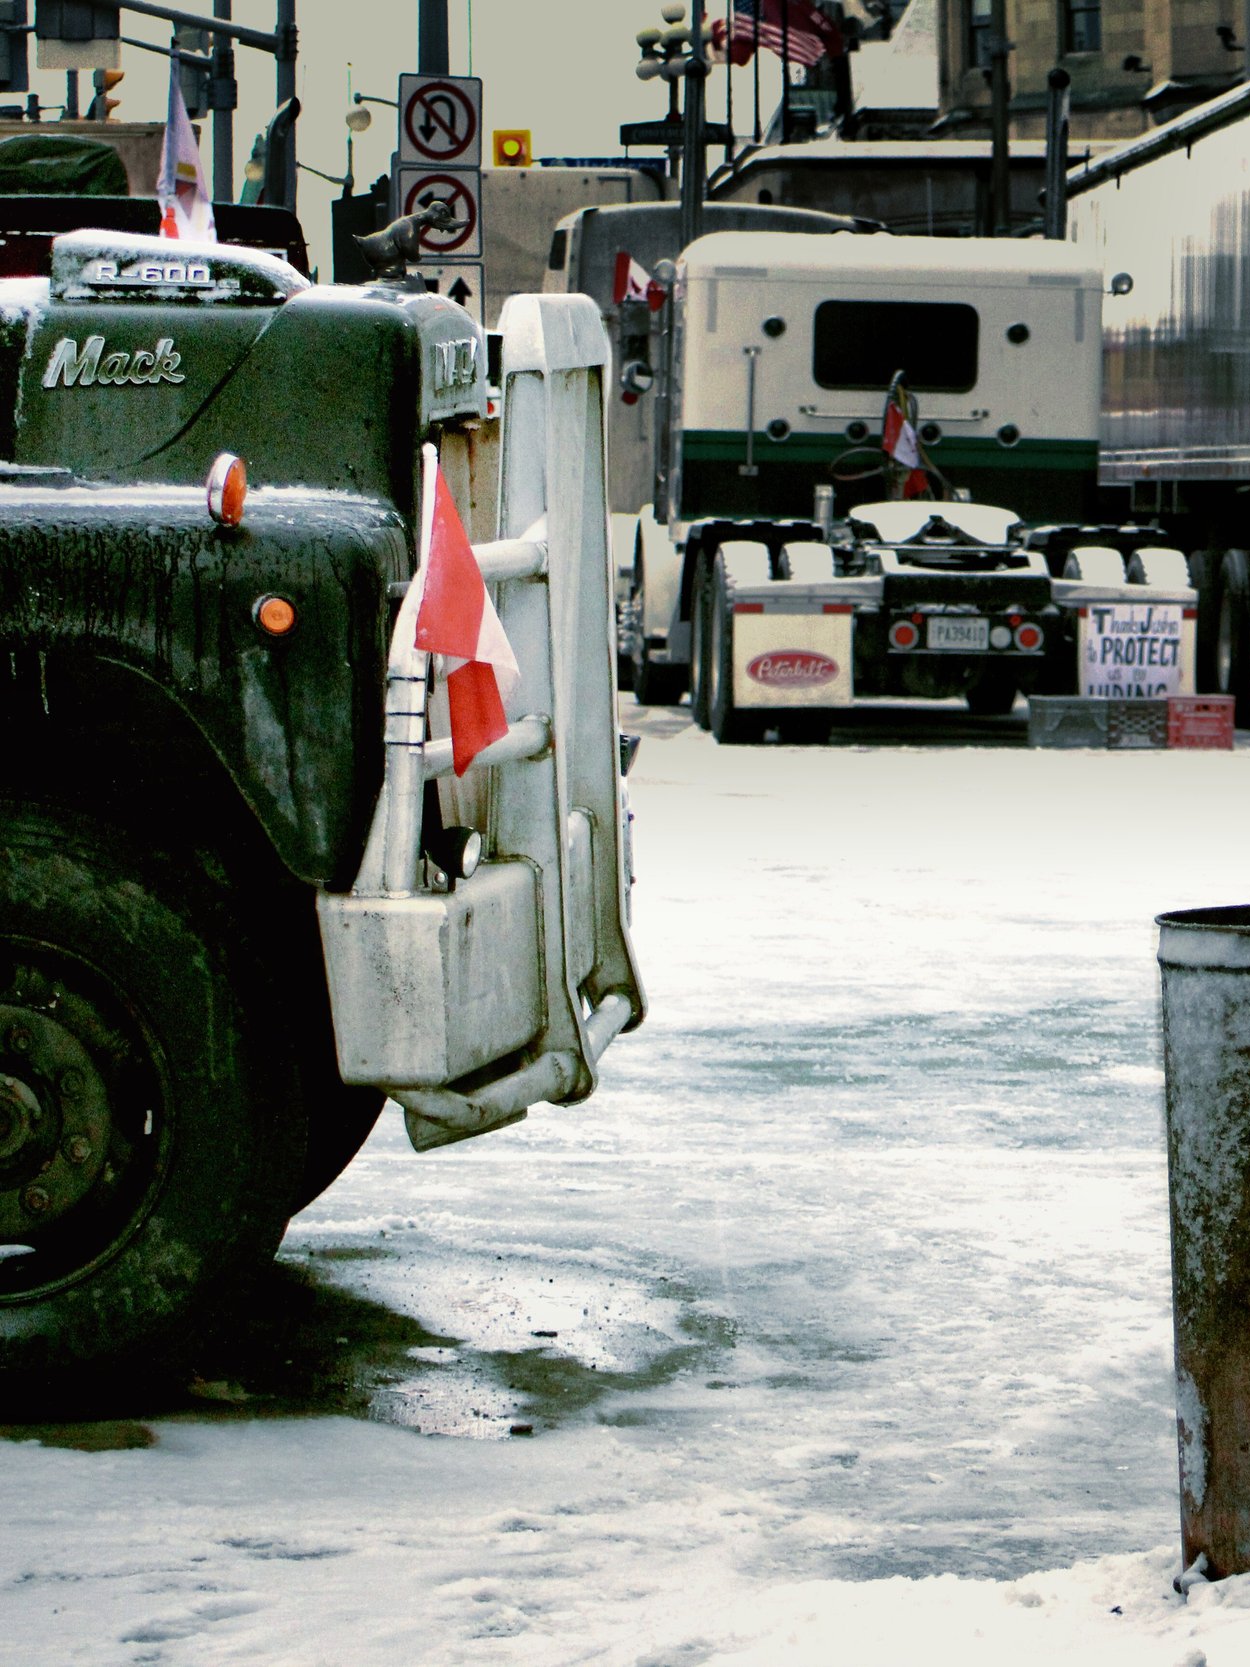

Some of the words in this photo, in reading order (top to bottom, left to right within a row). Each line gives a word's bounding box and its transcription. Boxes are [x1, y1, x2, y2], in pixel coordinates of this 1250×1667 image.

[96, 262, 211, 283] R-600
[42, 335, 186, 388] Mack
[1101, 637, 1180, 667] PROTECT
